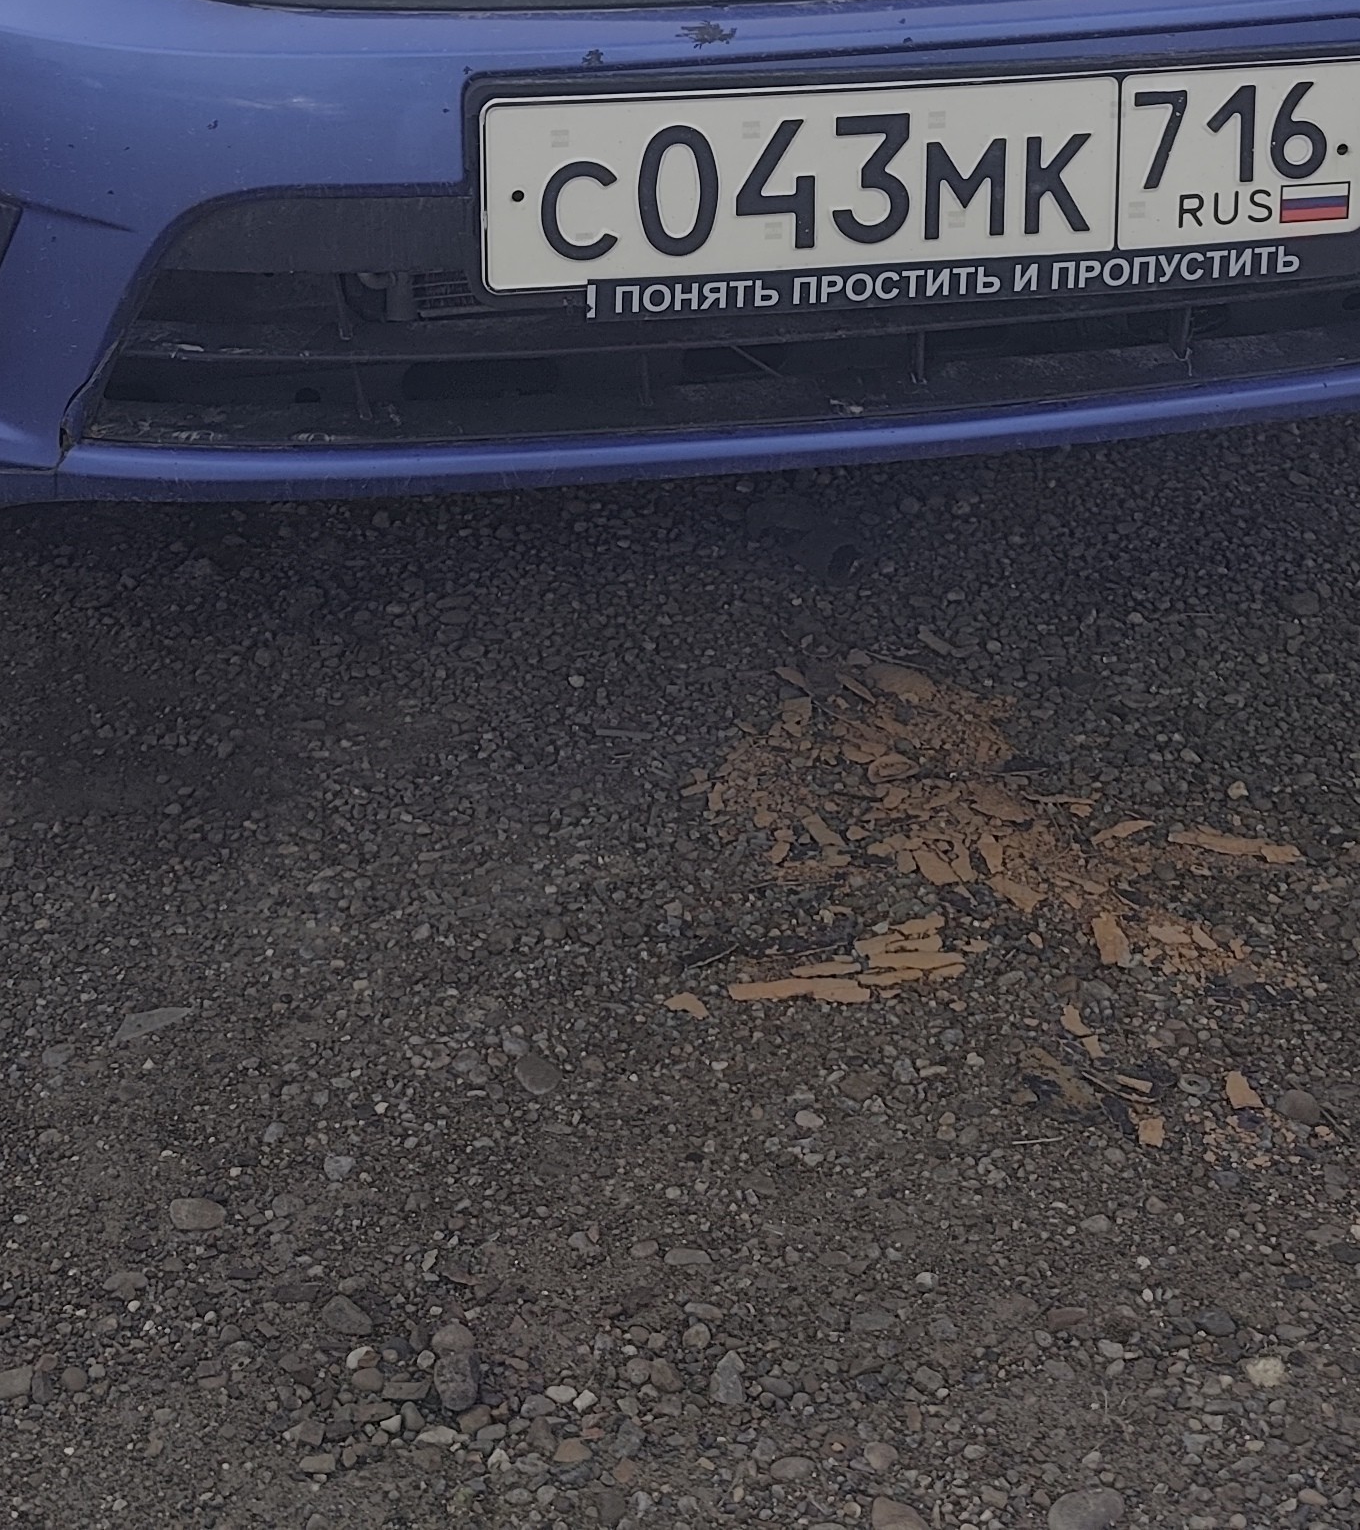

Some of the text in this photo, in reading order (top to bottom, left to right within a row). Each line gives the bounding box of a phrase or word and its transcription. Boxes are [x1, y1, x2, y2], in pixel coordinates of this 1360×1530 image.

[1133, 81, 1328, 190] 716
[1177, 188, 1274, 229] RUS
[614, 245, 1300, 314] ПОНЯТЬ ПРОСТИТЬ И ПРОПУСТИТЬ
